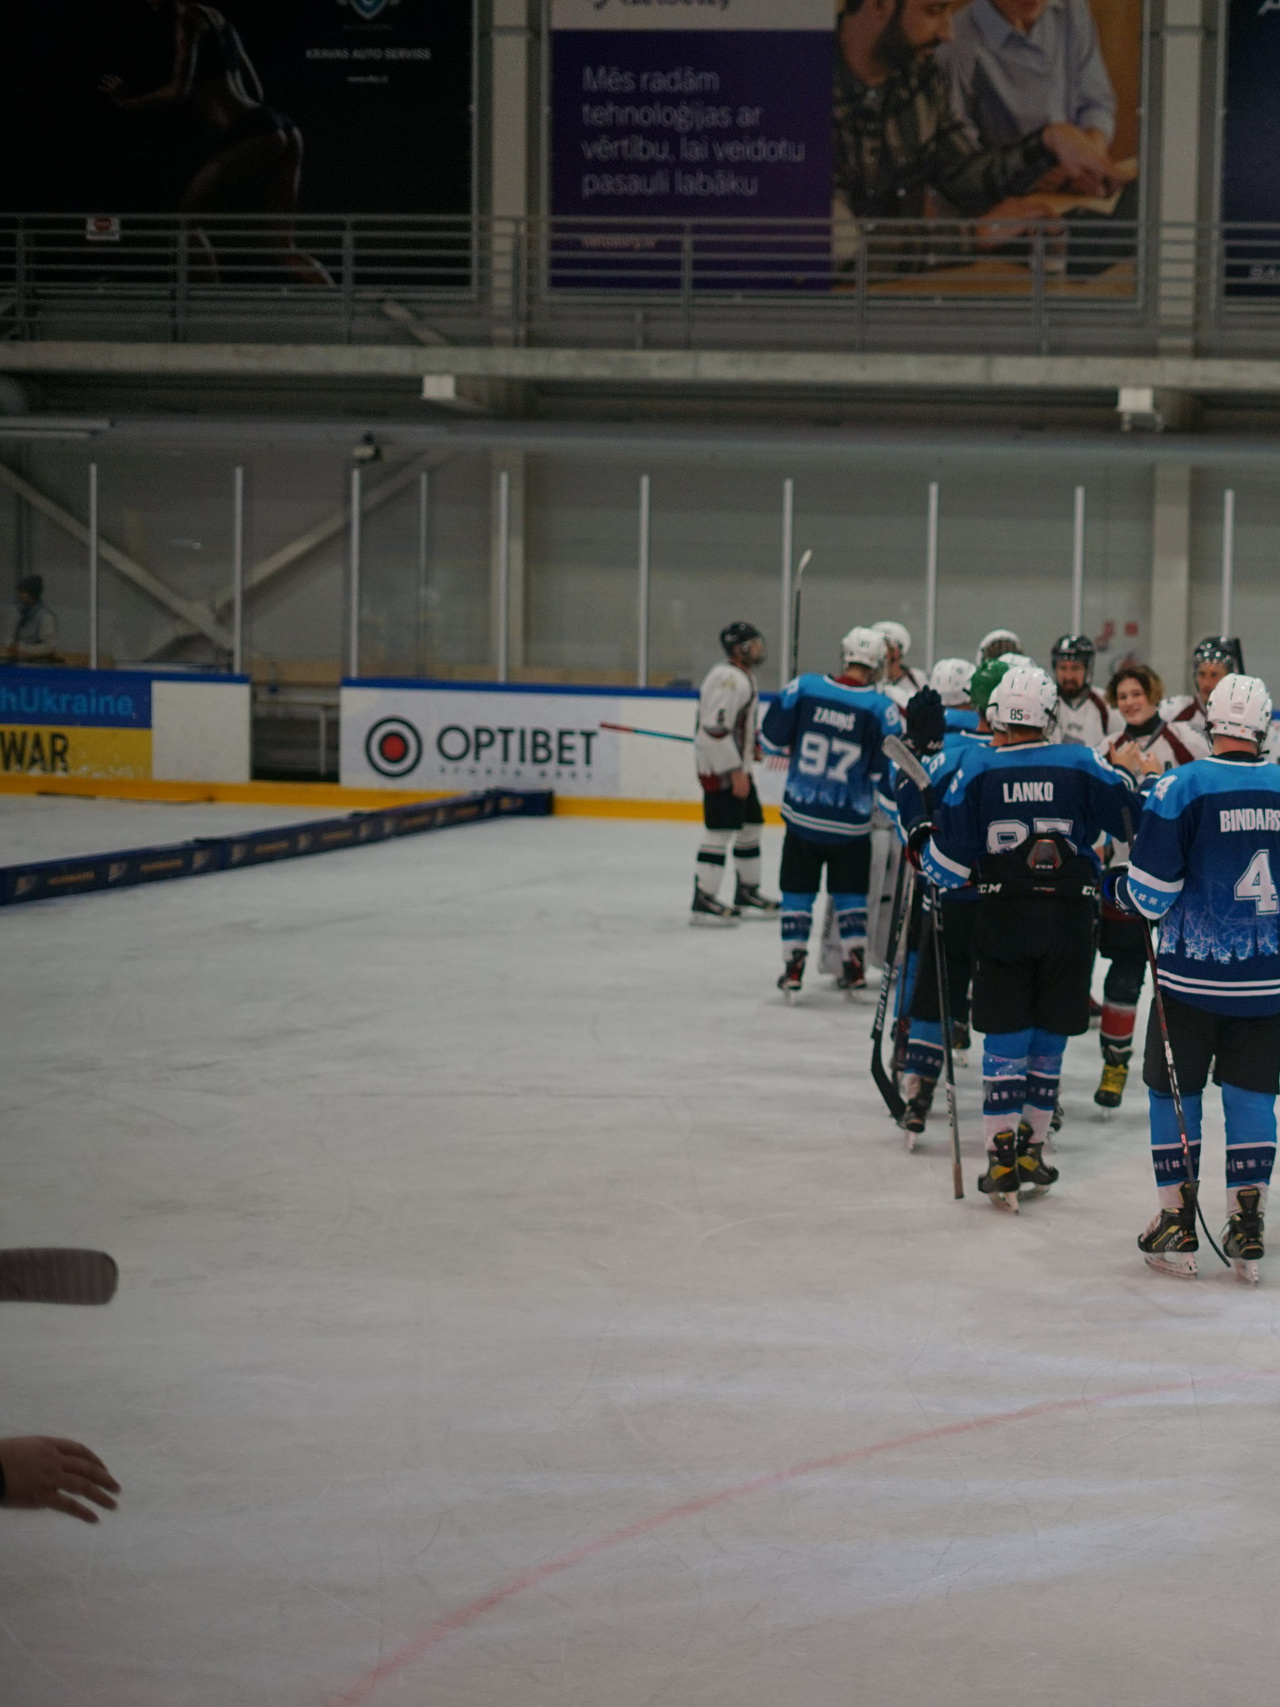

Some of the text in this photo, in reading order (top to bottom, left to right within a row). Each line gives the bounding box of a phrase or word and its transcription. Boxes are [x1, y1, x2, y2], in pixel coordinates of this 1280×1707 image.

[351, 47, 382, 60] AUTO
[581, 65, 720, 93] Mēs radām
[581, 100, 763, 133] tehnoloģijas ar
[679, 135, 709, 162] lai
[712, 136, 806, 163] veidotu
[581, 169, 759, 200] pasauli labāku
[1010, 709, 1024, 721] 85
[0, 730, 70, 774] WAR
[436, 725, 598, 767] OPTIBET
[798, 730, 863, 785] 97
[1002, 781, 1054, 804] LANKO
[1234, 849, 1280, 916] 4
